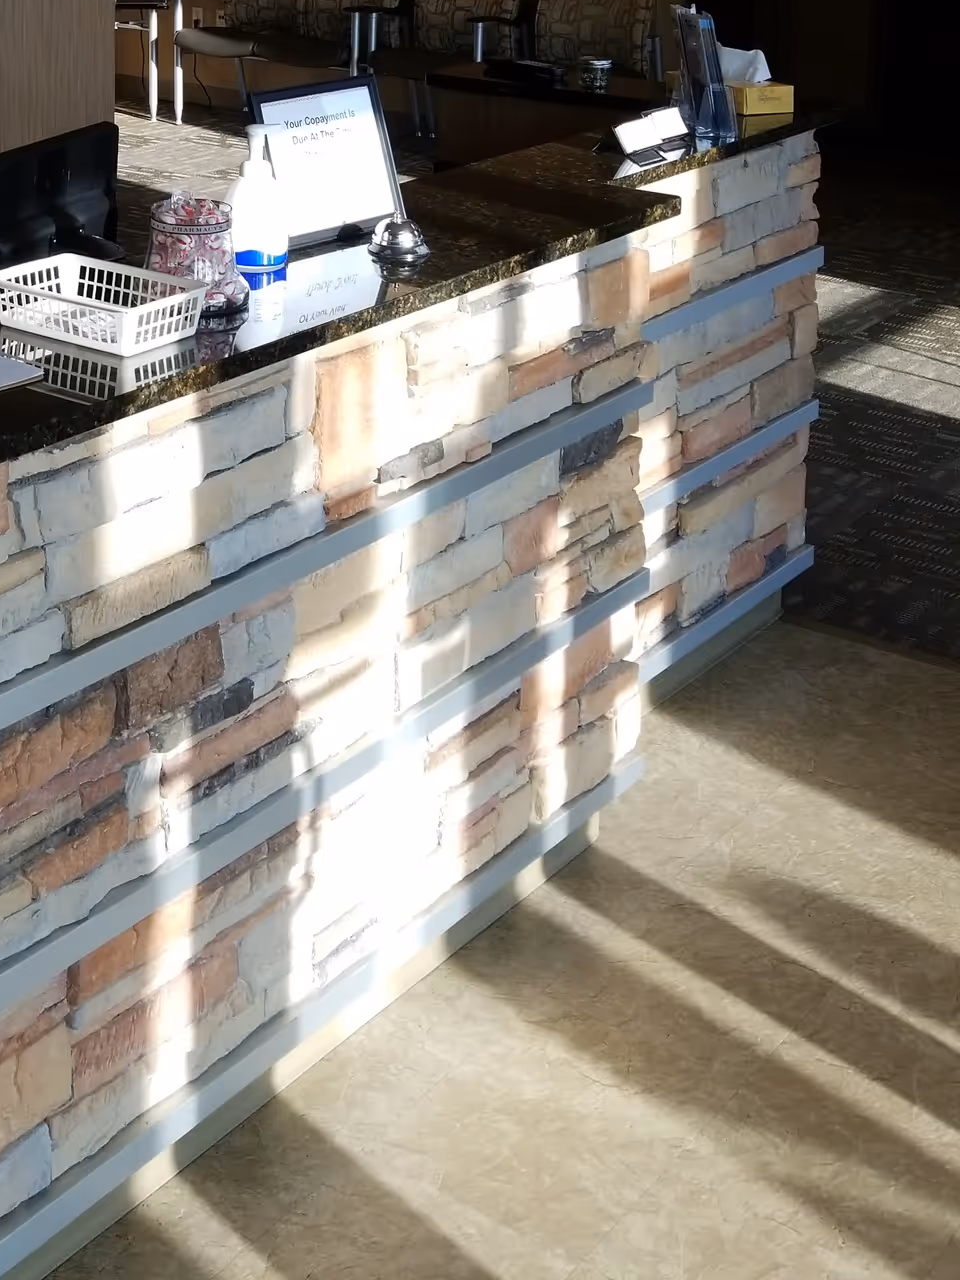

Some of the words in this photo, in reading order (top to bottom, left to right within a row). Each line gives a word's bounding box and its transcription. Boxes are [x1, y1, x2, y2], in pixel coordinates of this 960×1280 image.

[284, 119, 302, 130] Your
[305, 110, 348, 126] Copayment
[347, 108, 356, 118] Is
[292, 134, 308, 146] Due
[319, 130, 335, 138] The
